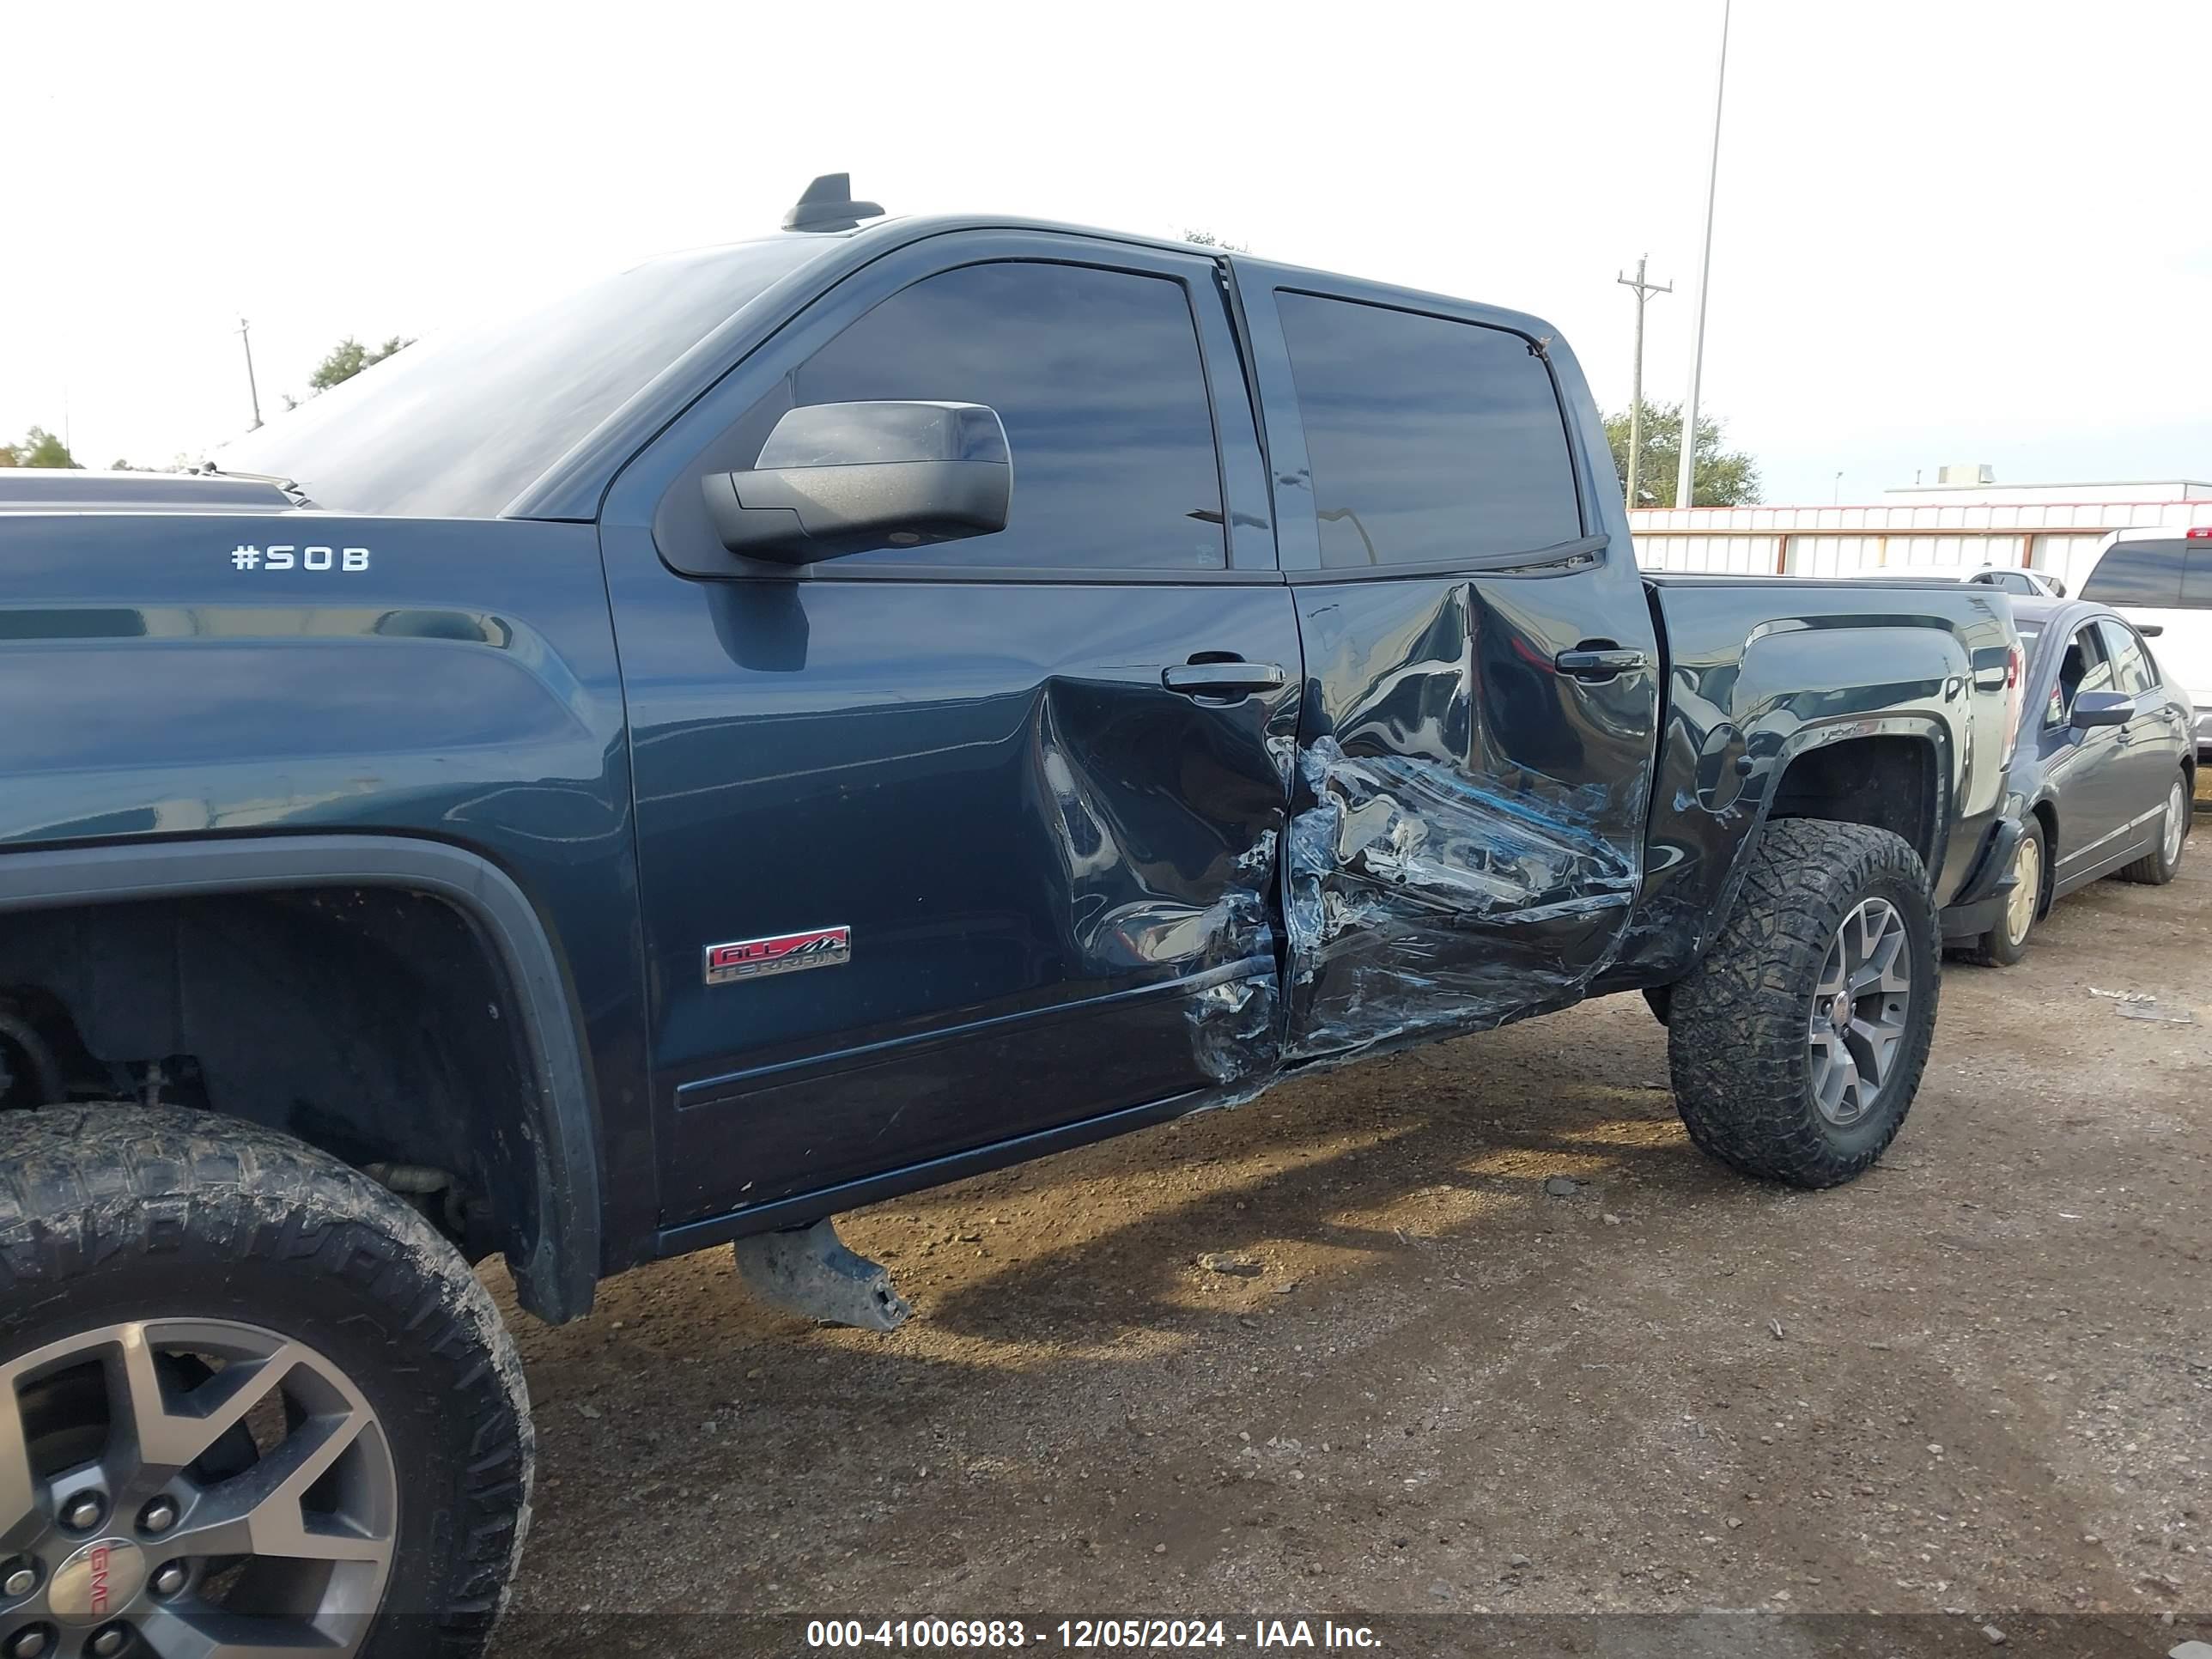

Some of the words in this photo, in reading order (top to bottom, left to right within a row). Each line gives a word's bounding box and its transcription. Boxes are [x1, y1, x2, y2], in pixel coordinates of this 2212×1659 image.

[230, 544, 370, 572] #SOB
[714, 951, 847, 978] TERRAIN
[720, 943, 783, 963] ALL
[90, 1547, 110, 1616] GMC
